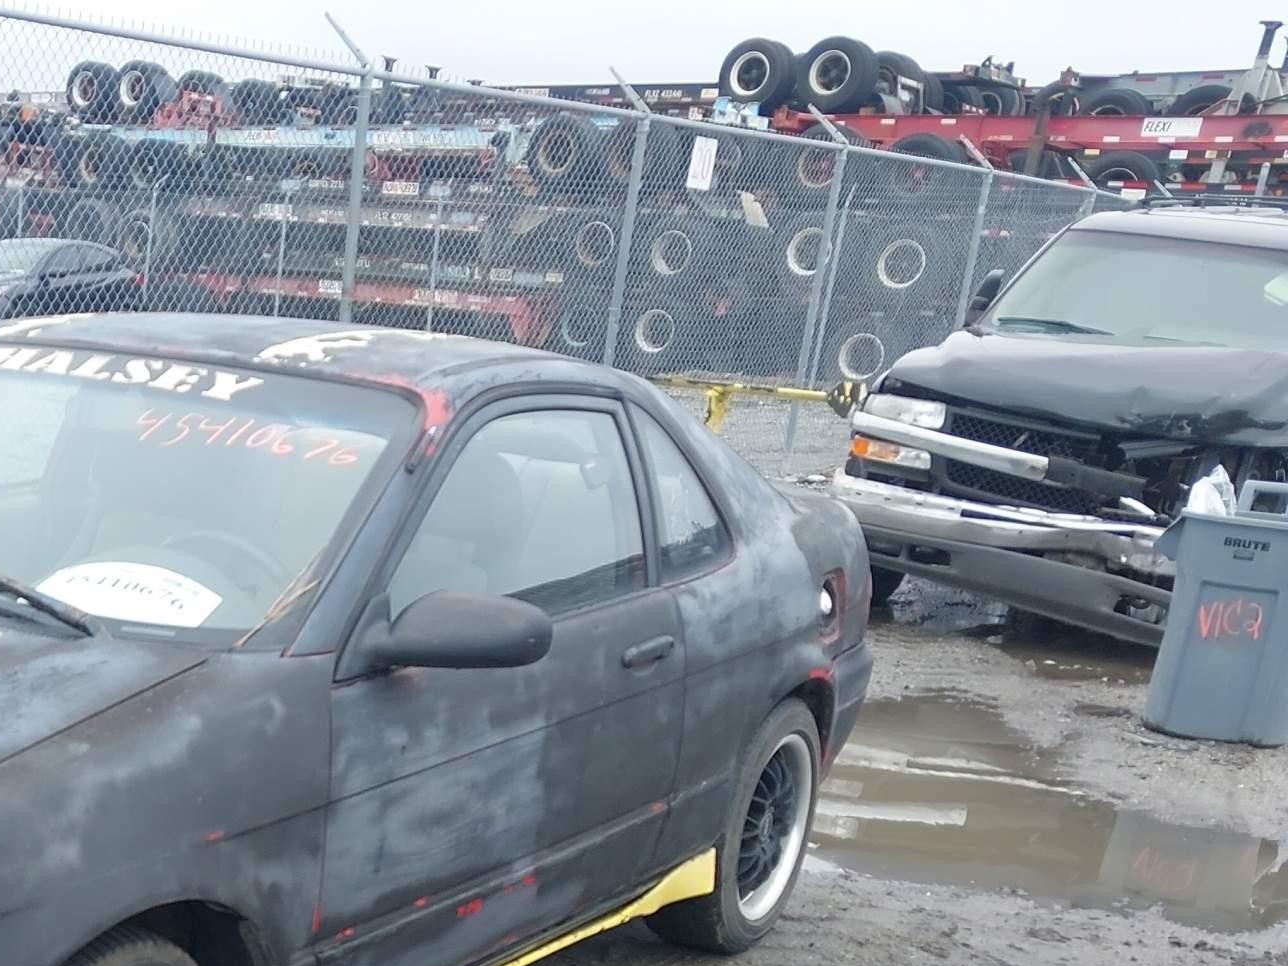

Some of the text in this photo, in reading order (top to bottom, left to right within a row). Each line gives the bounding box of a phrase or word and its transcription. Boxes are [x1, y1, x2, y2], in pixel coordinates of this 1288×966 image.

[1144, 120, 1172, 132] FLEXI
[136, 408, 359, 465] 45410676
[1223, 536, 1271, 552] BRUTE
